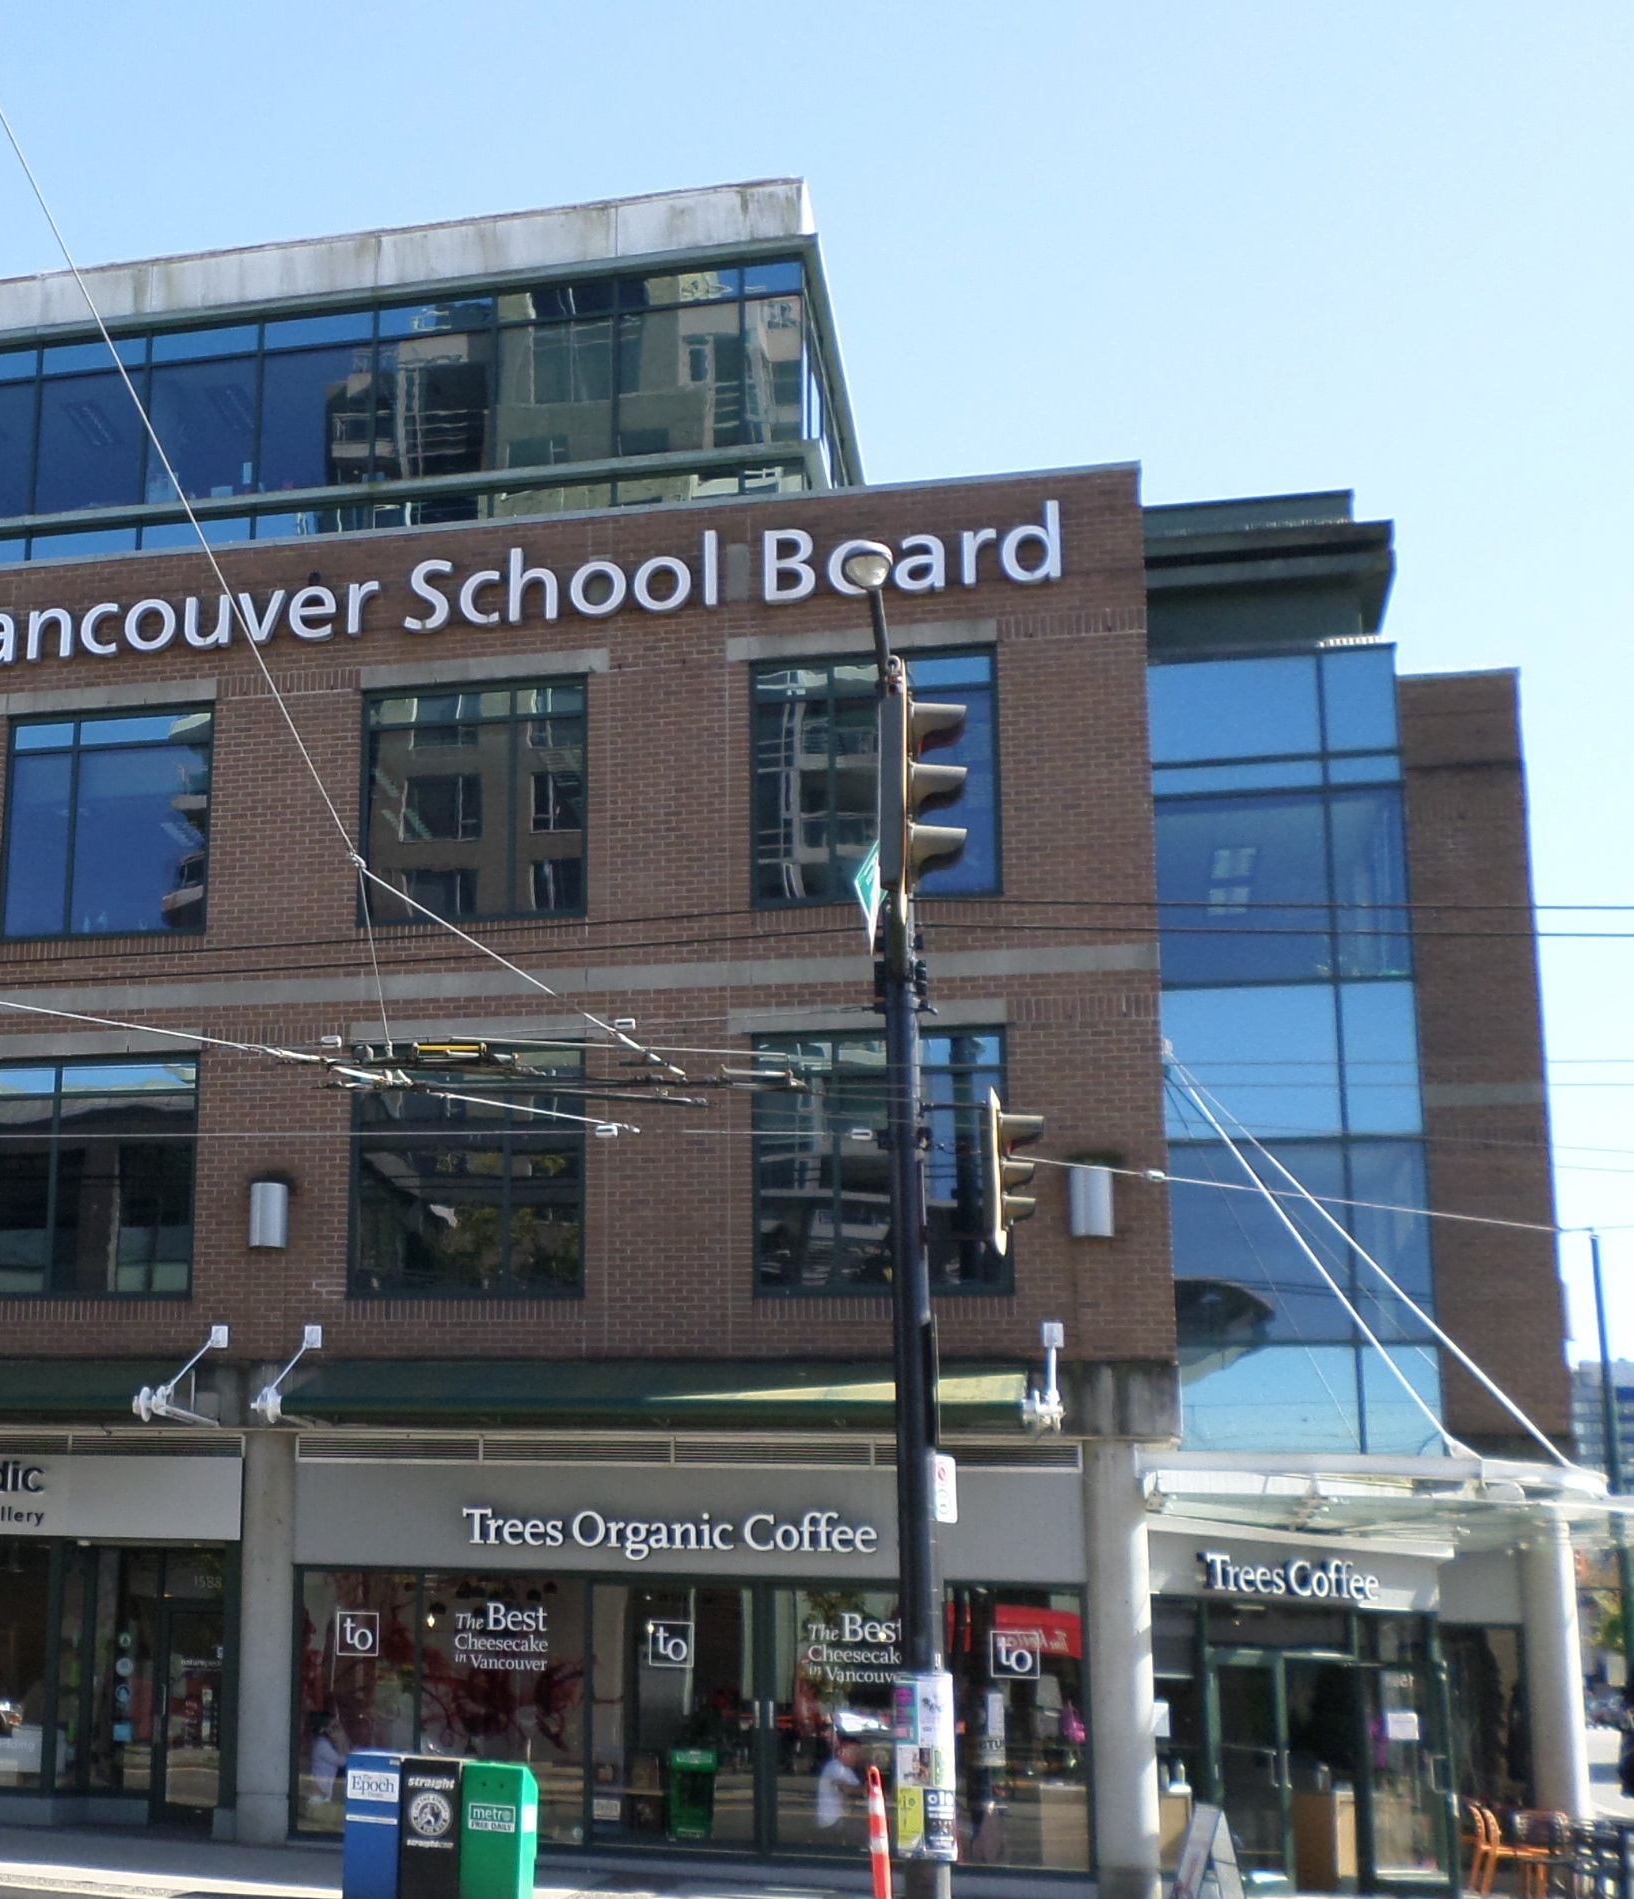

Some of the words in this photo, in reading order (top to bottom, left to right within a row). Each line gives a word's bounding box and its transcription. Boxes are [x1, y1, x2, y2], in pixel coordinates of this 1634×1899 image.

[404, 530, 720, 634] School
[762, 499, 1063, 606] Board
[462, 1506, 564, 1548] Trees
[572, 1510, 735, 1562] Organic
[743, 1511, 878, 1555] Coffee
[1205, 1552, 1286, 1595] Trees
[1287, 1558, 1381, 1601] Coffee
[455, 1612, 484, 1631] The
[486, 1601, 548, 1632] Best
[343, 1616, 373, 1651] to
[454, 1633, 548, 1652] Cheesecake
[807, 1623, 839, 1642] The
[655, 1626, 688, 1662] to
[997, 1636, 1033, 1673] to
[455, 1651, 467, 1664] in
[469, 1654, 548, 1671] Vancouver
[809, 1665, 823, 1677] in
[351, 1775, 395, 1796] Epoch
[407, 1777, 455, 1791] straight
[472, 1807, 513, 1823] metro
[471, 1821, 489, 1831] FREE
[491, 1823, 513, 1832] DAILY
